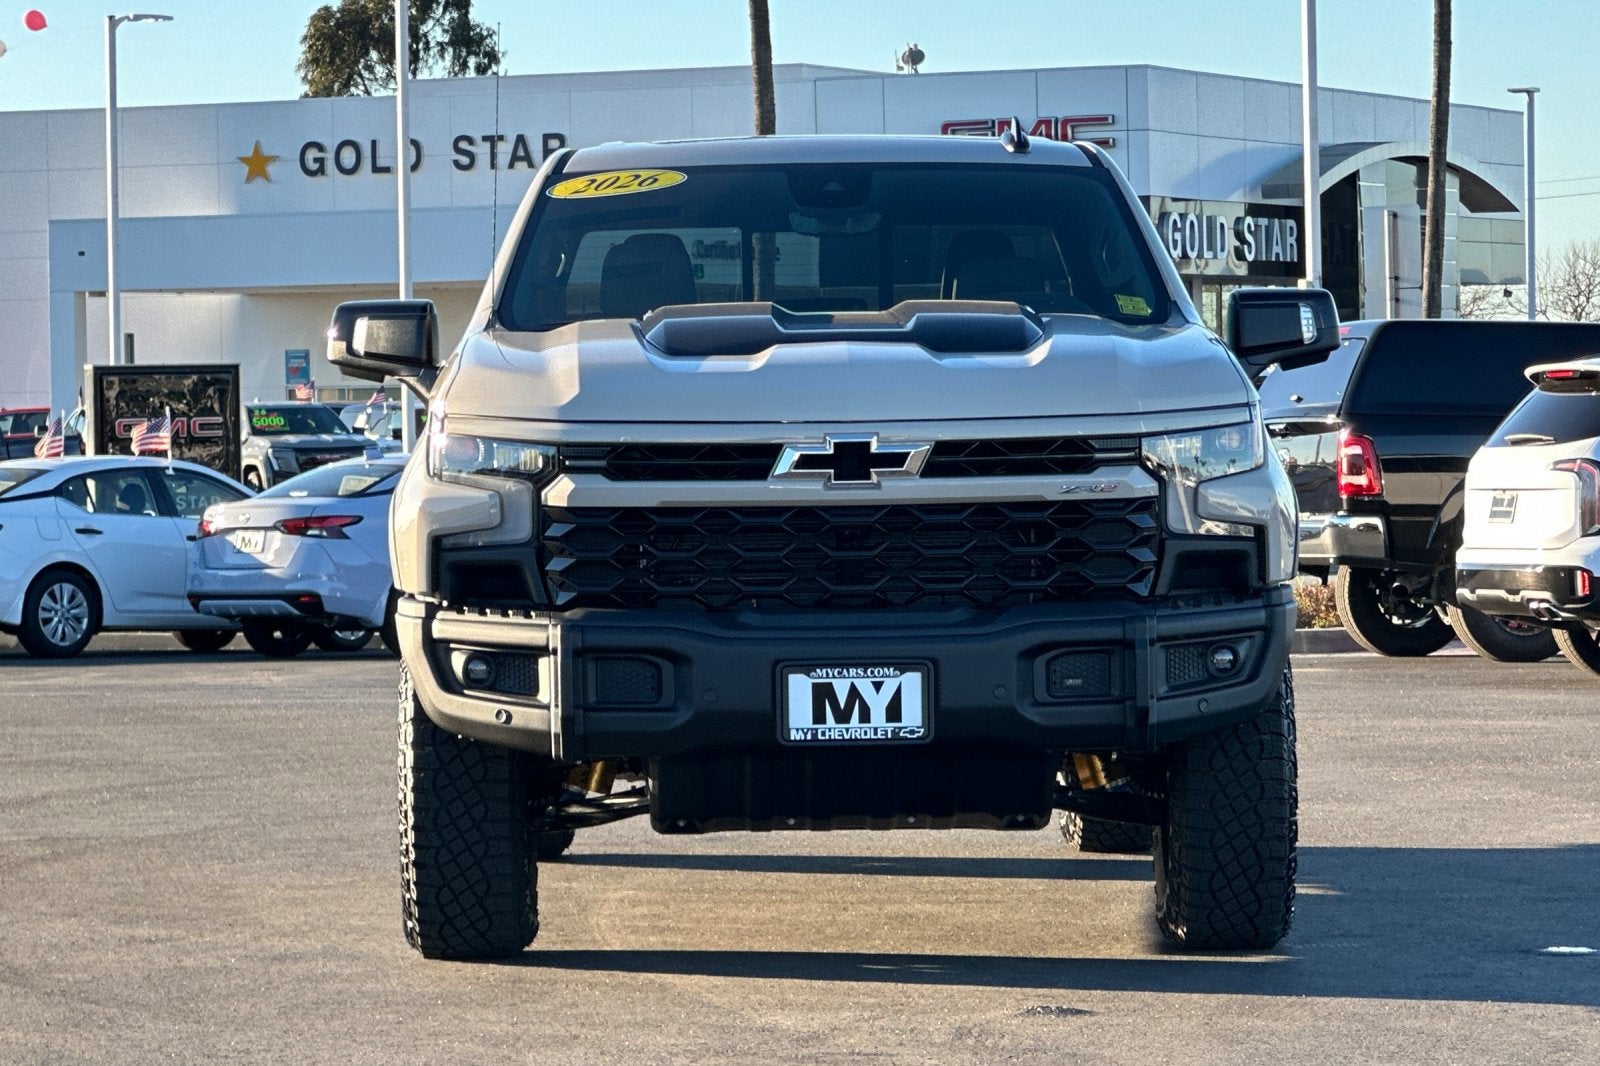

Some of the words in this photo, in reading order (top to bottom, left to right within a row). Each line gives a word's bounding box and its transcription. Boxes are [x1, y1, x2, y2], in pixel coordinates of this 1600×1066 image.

[569, 172, 665, 195] 2026
[1164, 212, 1229, 259] GOLD
[1238, 215, 1298, 263] STAR
[815, 667, 895, 678] MYCARS.COM
[811, 680, 903, 725] MY
[790, 728, 812, 741] MY
[817, 727, 895, 740] CHEVROLET
